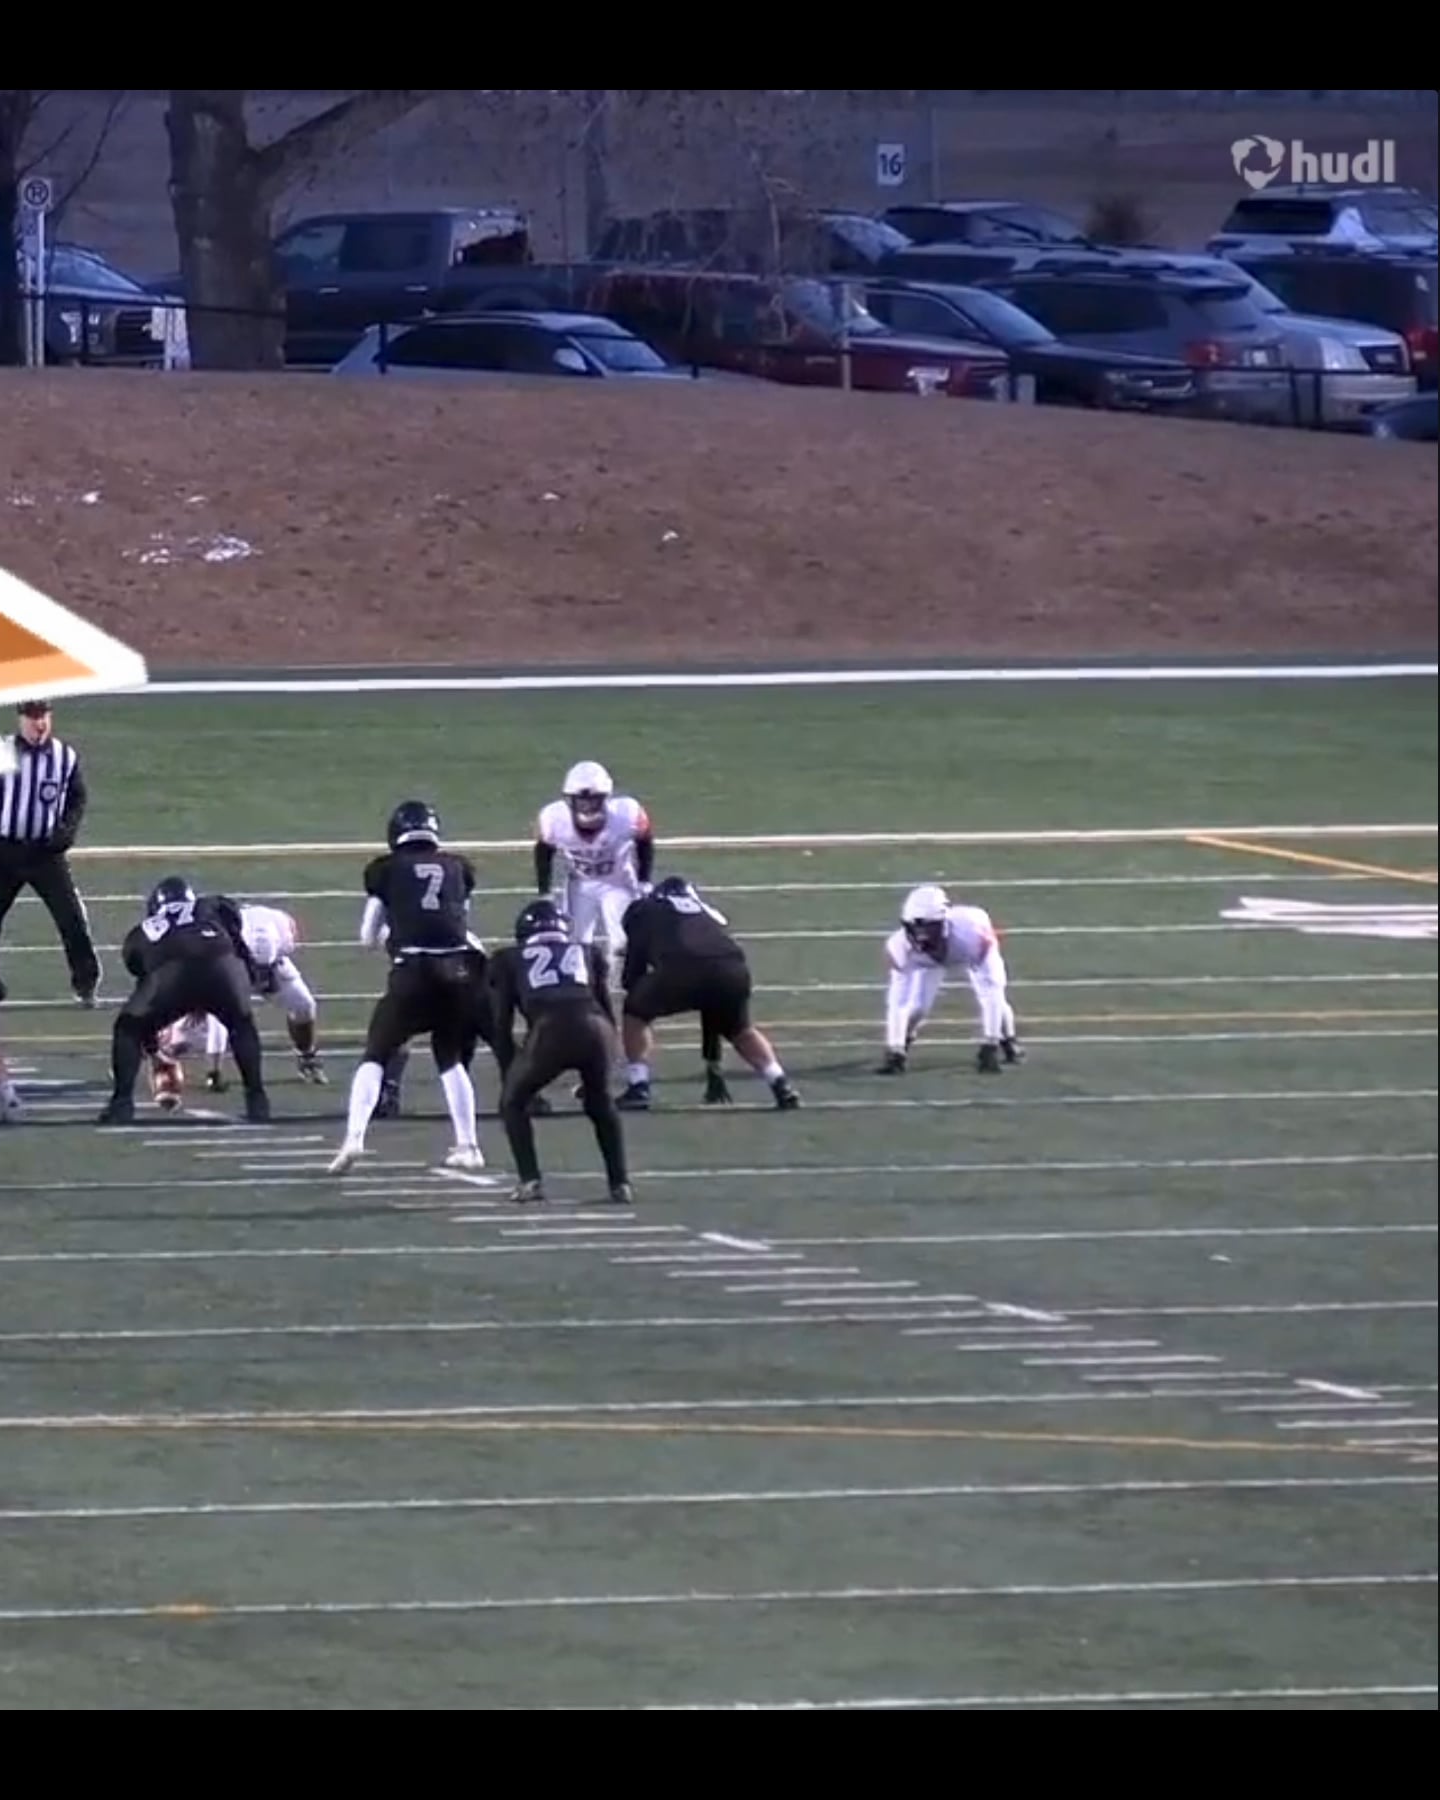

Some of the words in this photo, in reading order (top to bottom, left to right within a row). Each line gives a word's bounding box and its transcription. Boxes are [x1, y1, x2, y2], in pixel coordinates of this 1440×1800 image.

[880, 153, 901, 176] 16
[414, 863, 444, 910] 7
[523, 945, 588, 988] 24
